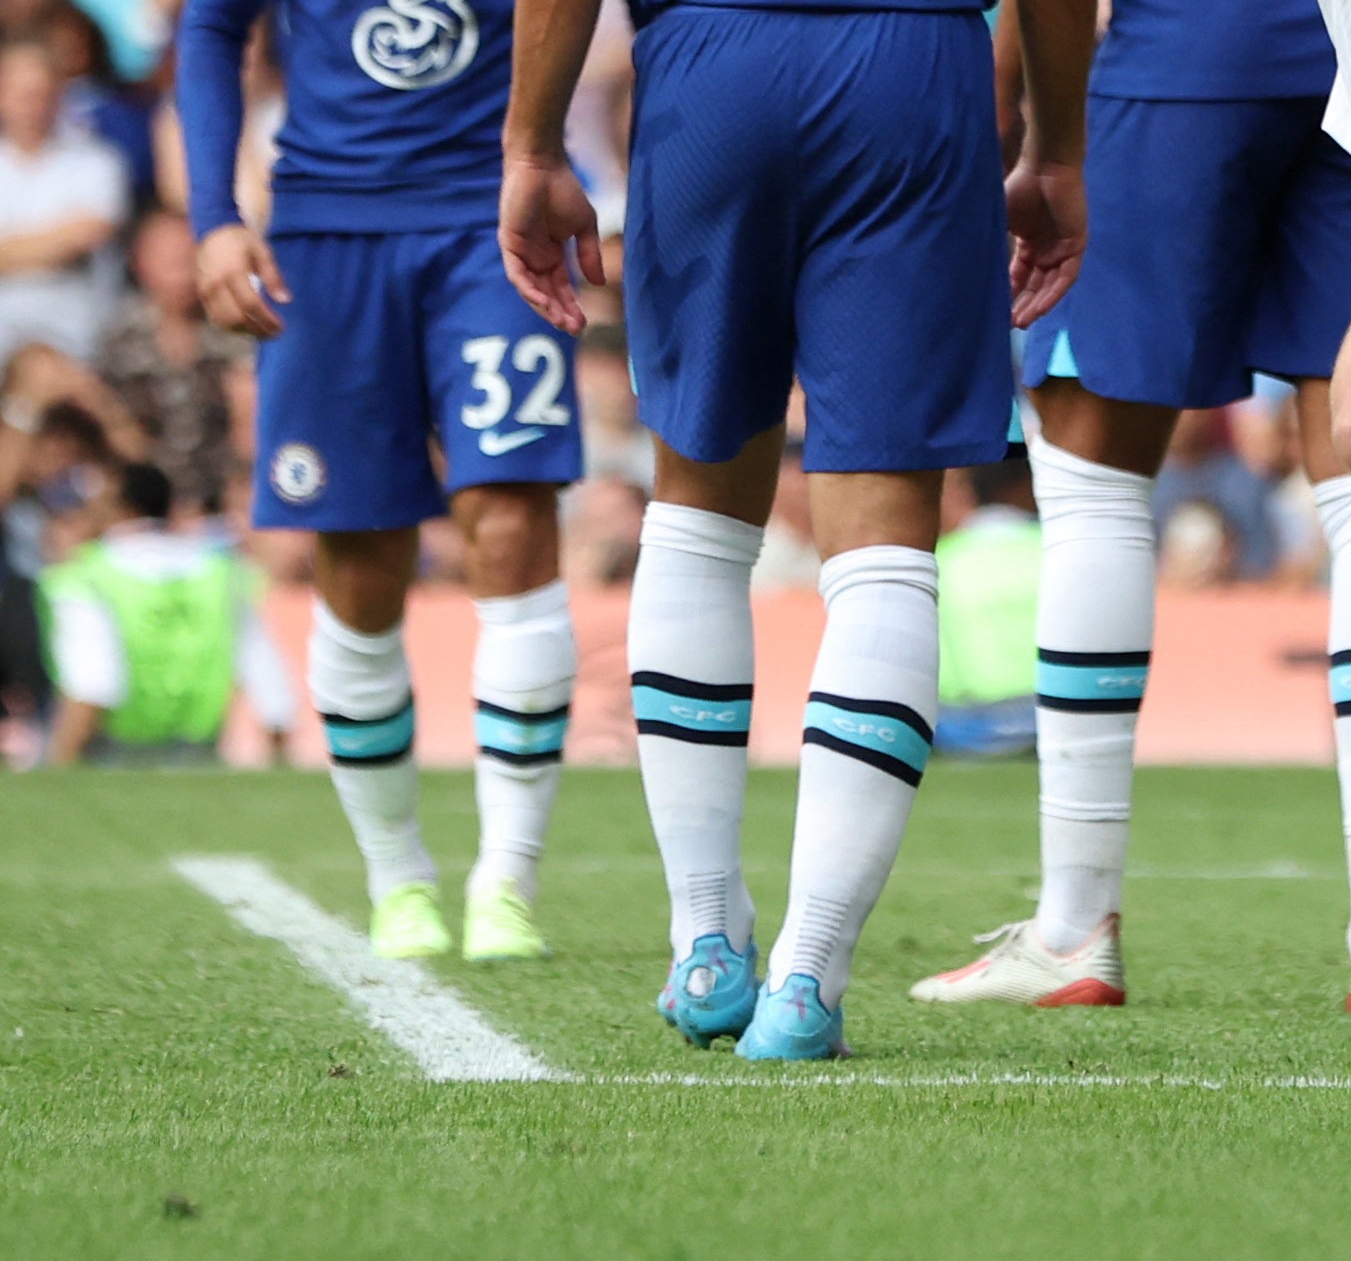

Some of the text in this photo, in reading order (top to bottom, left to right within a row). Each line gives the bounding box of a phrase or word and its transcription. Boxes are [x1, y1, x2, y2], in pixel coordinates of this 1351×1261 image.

[460, 334, 572, 430] 32
[668, 703, 738, 724] CFC
[831, 715, 897, 743] CFC
